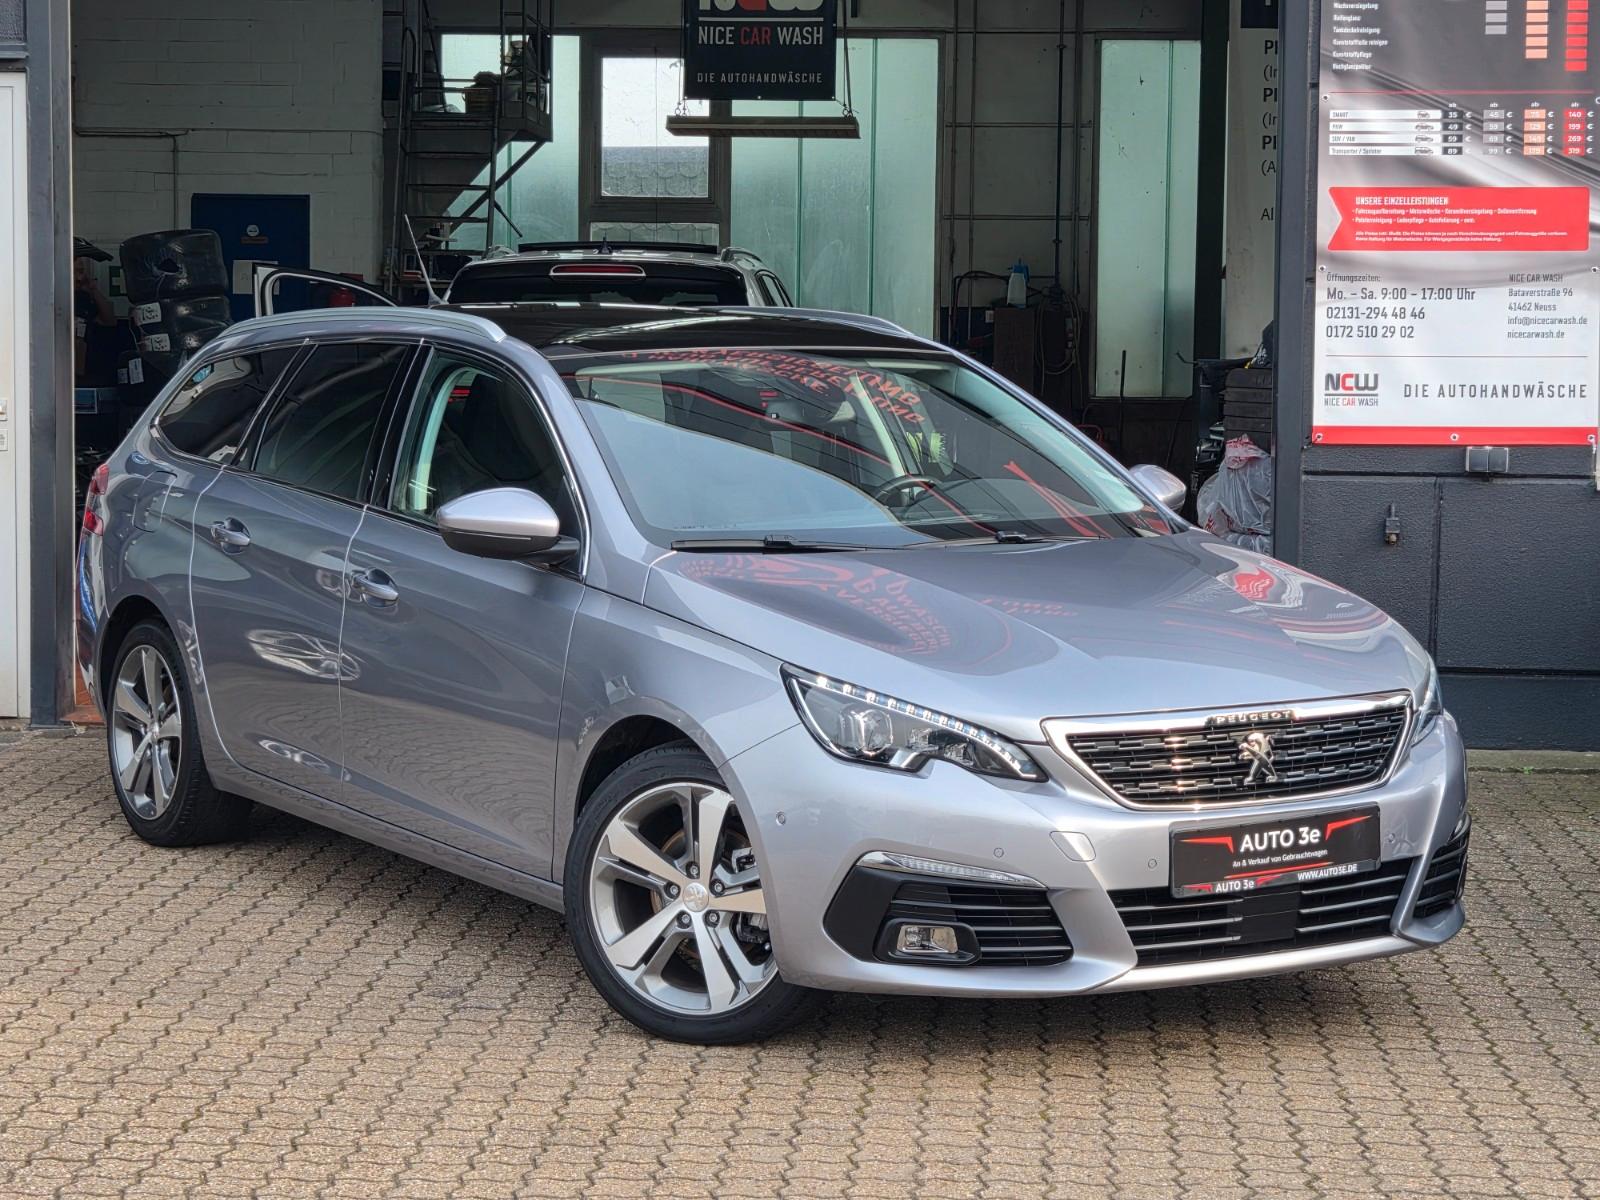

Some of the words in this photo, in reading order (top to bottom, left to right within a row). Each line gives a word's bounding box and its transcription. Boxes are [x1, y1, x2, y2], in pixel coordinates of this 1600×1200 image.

[698, 26, 735, 45] NICE
[740, 26, 771, 45] CAR
[778, 26, 823, 45] WASH
[697, 72, 716, 83] DIE
[720, 71, 822, 83] AUTOHANDWÄSCHE
[1355, 196, 1382, 205] UNSERE
[1384, 196, 1449, 205] EINZELLEISTUNGEN
[1327, 272, 1380, 283] Öffnungszeiten:
[1508, 273, 1525, 282] NICE
[1527, 273, 1541, 282] CAR
[1542, 273, 1563, 282] WASH
[1327, 287, 1346, 300] Mo.
[1361, 287, 1377, 300] Sa.
[1381, 287, 1406, 300] 9:00
[1421, 288, 1452, 300] 17:00
[1457, 288, 1476, 300] Uhr
[1508, 288, 1560, 297] Bataverstraße
[1562, 288, 1573, 297] 96
[1508, 302, 1532, 311] 41462
[1534, 302, 1557, 311] Neuss
[1326, 307, 1388, 319] 02131-294
[1392, 307, 1406, 319] 48
[1410, 307, 1425, 319] 46
[1508, 316, 1588, 326] info@nicecarwash.de
[1326, 325, 1353, 338] 0172
[1357, 325, 1378, 338] 510
[1381, 325, 1396, 338] 29
[1400, 326, 1414, 338] 02
[1507, 330, 1564, 338] nicecarwash.de
[1325, 373, 1378, 391] NCW
[1404, 384, 1429, 398] DIE
[1438, 381, 1587, 398] AUTOHANDWÄSCHE
[1324, 398, 1340, 406] NICE
[1342, 398, 1355, 406] CAR
[1358, 398, 1378, 406] WASH
[1216, 710, 1290, 723] PEUGEOT
[1240, 830, 1294, 852] AUTO
[1298, 826, 1321, 845] 3e
[1248, 856, 1270, 865] Verkauf
[1282, 849, 1328, 861] Gebrauchtwagen
[1298, 864, 1357, 880] WWW.AUTO3E.DE
[1216, 881, 1241, 893] AUTO
[1243, 879, 1254, 889] 3e
